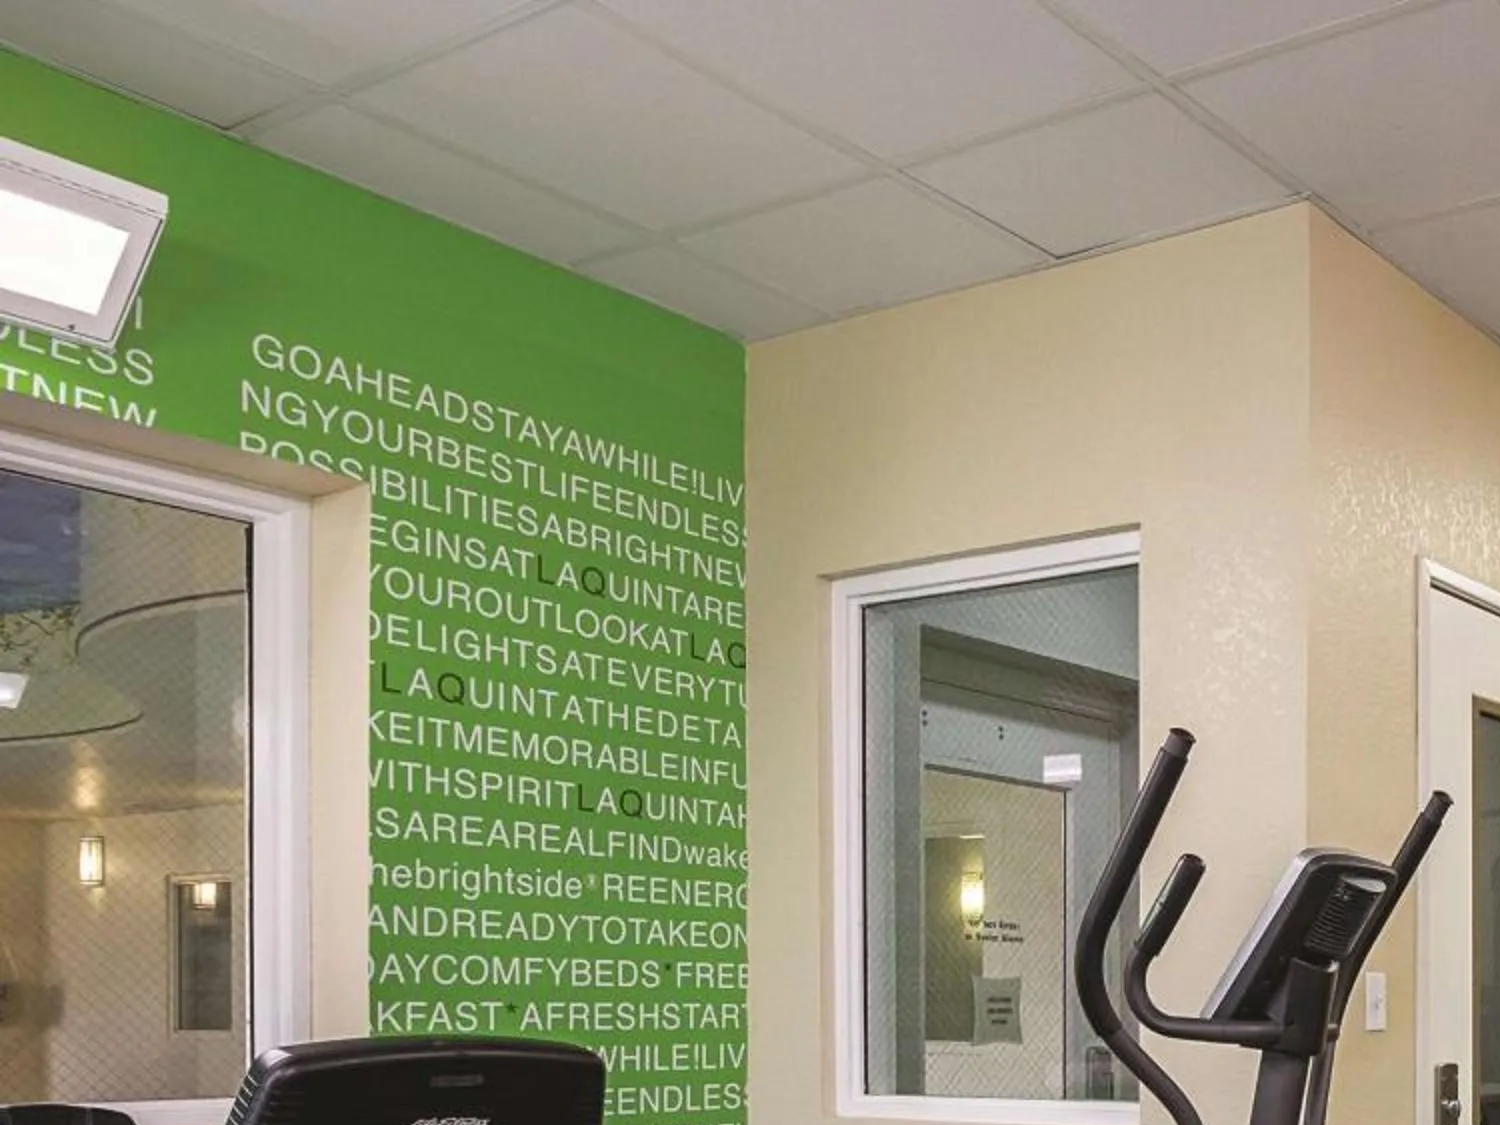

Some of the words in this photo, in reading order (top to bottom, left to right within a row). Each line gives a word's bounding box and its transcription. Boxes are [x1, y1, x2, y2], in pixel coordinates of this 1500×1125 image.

[0, 325, 154, 386] LESS
[369, 659, 742, 749] LAQUINTATHEDETA
[520, 1002, 748, 1032] AFRESHSTAR
[603, 1083, 748, 1117] EENDLES
